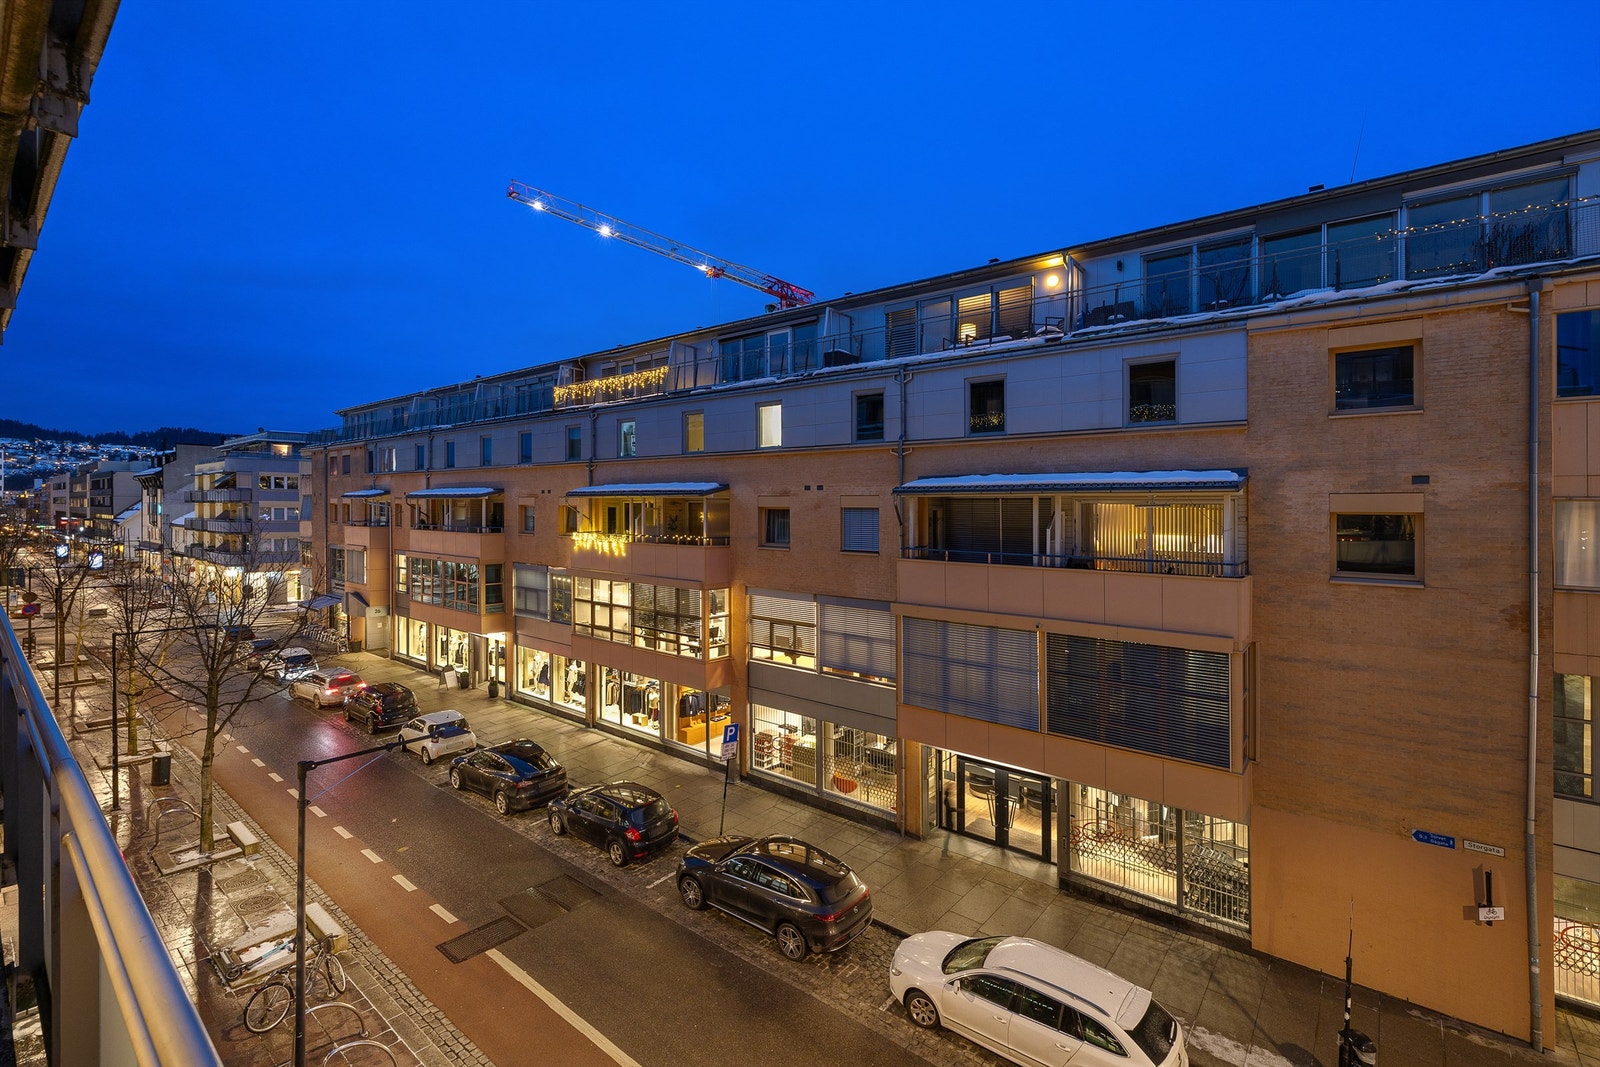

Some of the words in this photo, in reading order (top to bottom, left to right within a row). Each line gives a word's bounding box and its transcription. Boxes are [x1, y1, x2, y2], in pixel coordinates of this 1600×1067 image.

[727, 727, 736, 742] P
[1429, 832, 1447, 841] Torvet
[1468, 841, 1500, 854] Storgata
